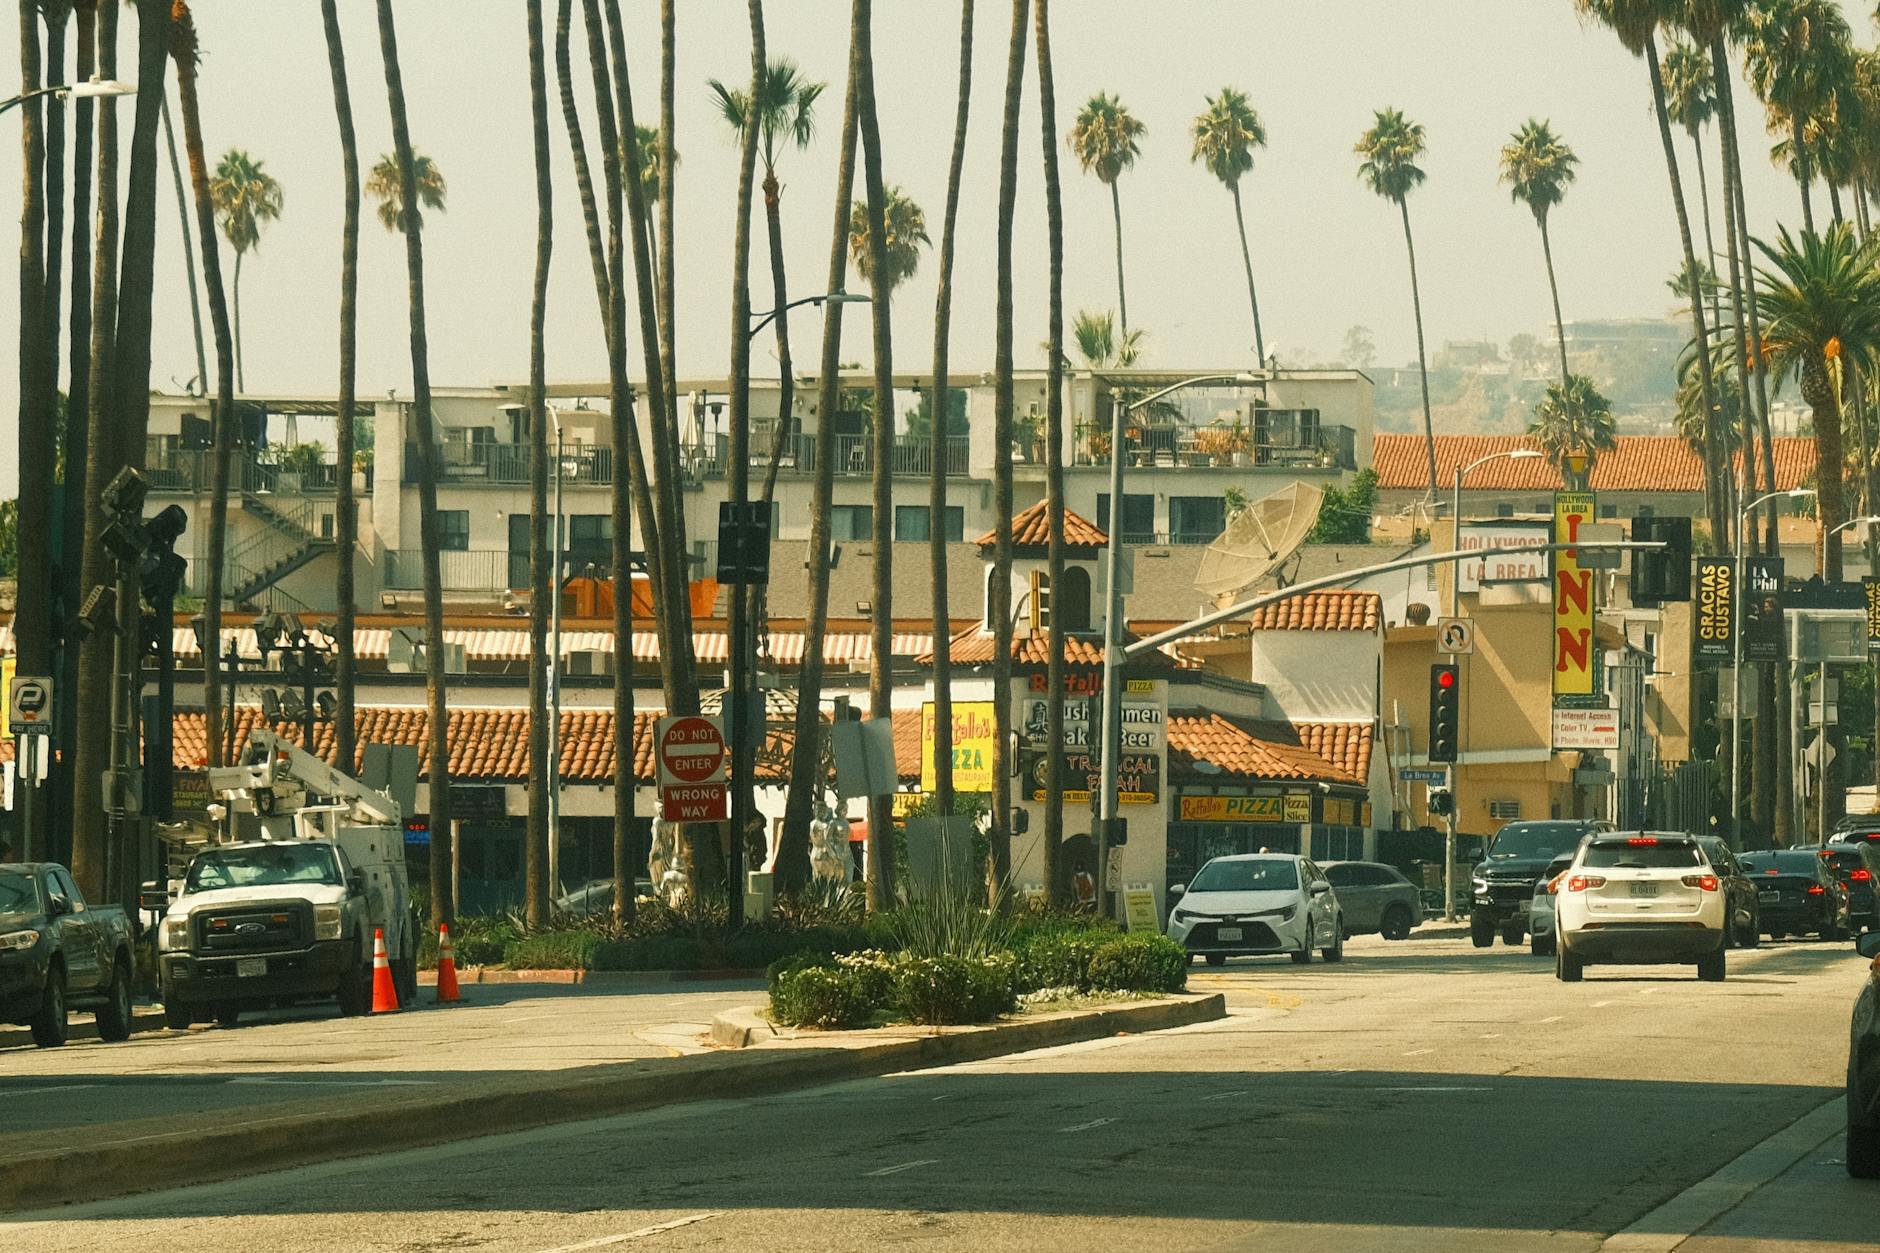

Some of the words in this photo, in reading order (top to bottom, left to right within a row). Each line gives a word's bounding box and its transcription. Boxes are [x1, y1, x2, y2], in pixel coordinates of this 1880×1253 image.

[1556, 495, 1593, 504] HOLLYWOOD
[1562, 504, 1570, 513] LA
[1572, 504, 1588, 513] BREA
[1467, 563, 1485, 580] LA
[1496, 563, 1537, 580] BREA
[1753, 566, 1768, 578] LA
[1752, 578, 1777, 590] Phil
[1700, 565, 1715, 640] GRACIAS
[1716, 565, 1731, 640] GUSTAVO
[1128, 681, 1154, 691] PIZZA
[1064, 703, 1090, 721] ush
[1121, 707, 1162, 723] men
[1561, 712, 1587, 720] Internet
[1589, 712, 1611, 720] Access
[1561, 724, 1577, 732] Color
[670, 731, 685, 741] DO
[692, 729, 714, 740] NOT
[1121, 729, 1157, 747] Beer
[675, 759, 712, 770] ENTER
[1067, 755, 1156, 774] TRCAL
[1087, 774, 1140, 791] FAH
[670, 789, 720, 800] WRONG
[681, 806, 709, 817] WAY
[1226, 799, 1280, 815] PIZZA
[1286, 811, 1308, 822] Slice
